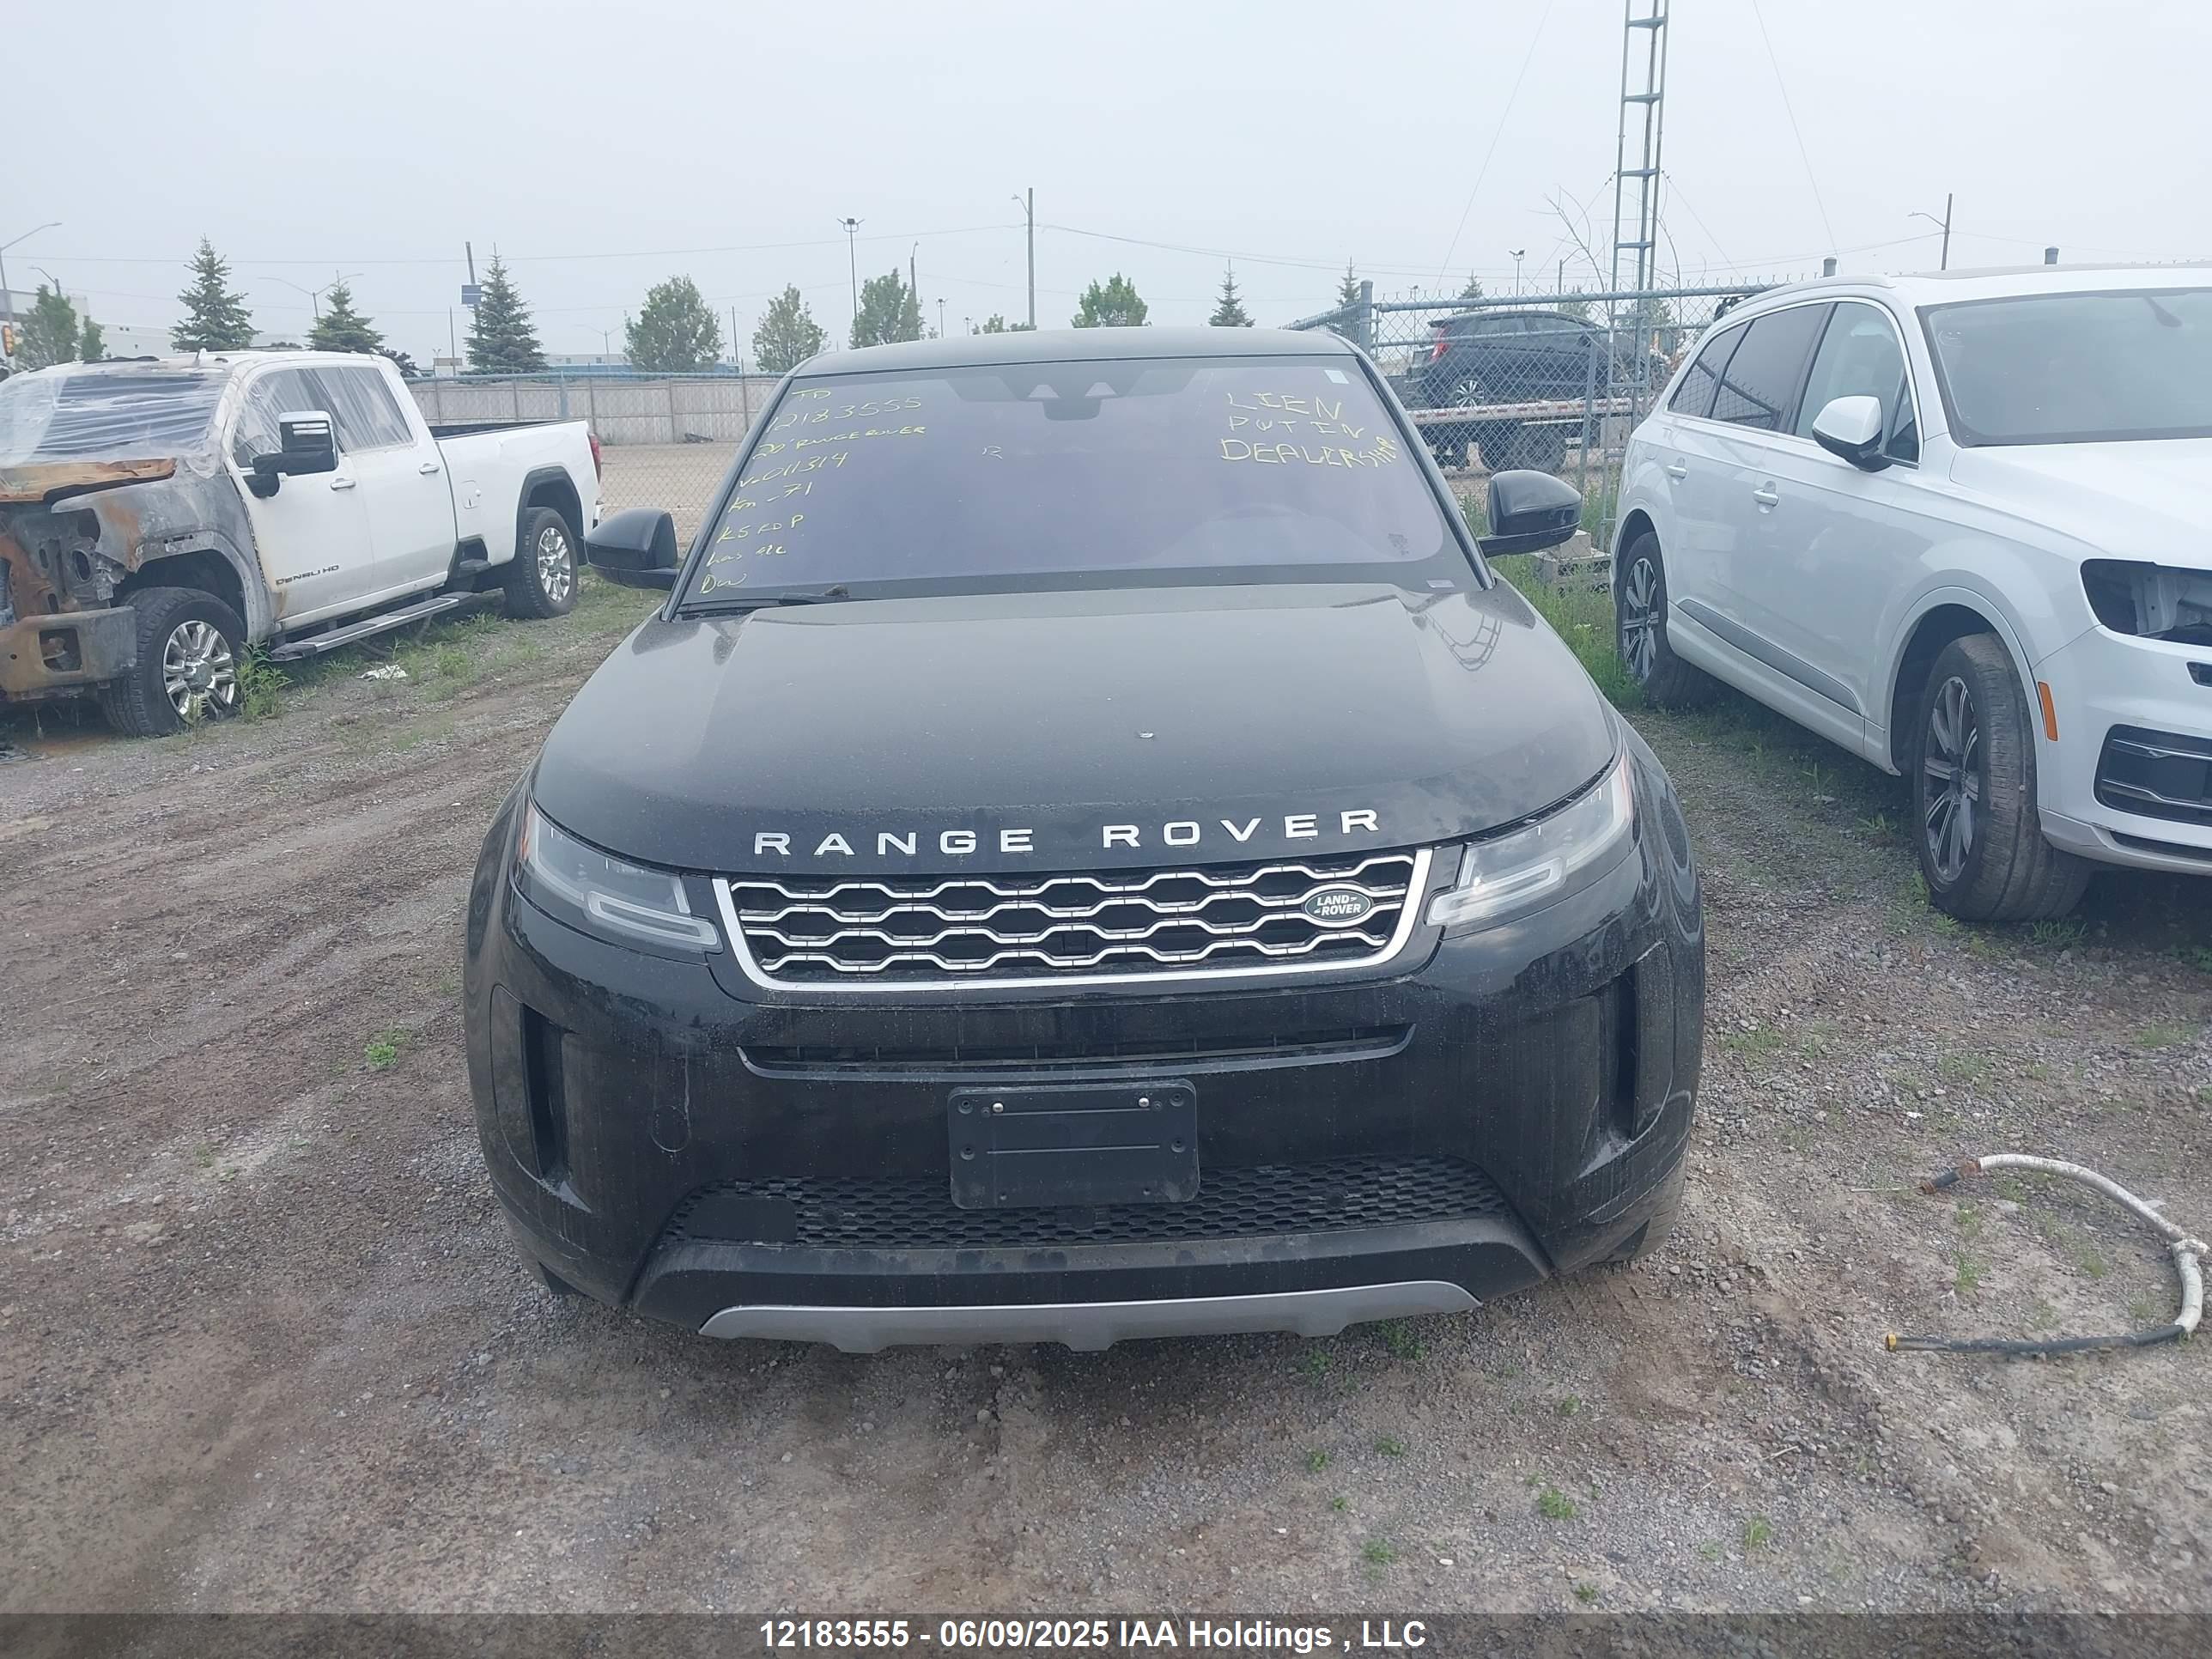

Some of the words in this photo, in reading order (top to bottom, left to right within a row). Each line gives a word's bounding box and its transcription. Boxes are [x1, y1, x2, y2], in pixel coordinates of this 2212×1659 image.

[765, 397, 921, 434] 12183555
[1227, 392, 1342, 420] LIEN
[865, 426, 927, 437] ROVER
[275, 568, 321, 585] DENALI
[322, 564, 340, 574] HD
[754, 829, 1035, 856] RANGE
[1103, 809, 1380, 848] ROVER
[1316, 894, 1350, 907] LAND
[1321, 903, 1363, 916] ROVER
